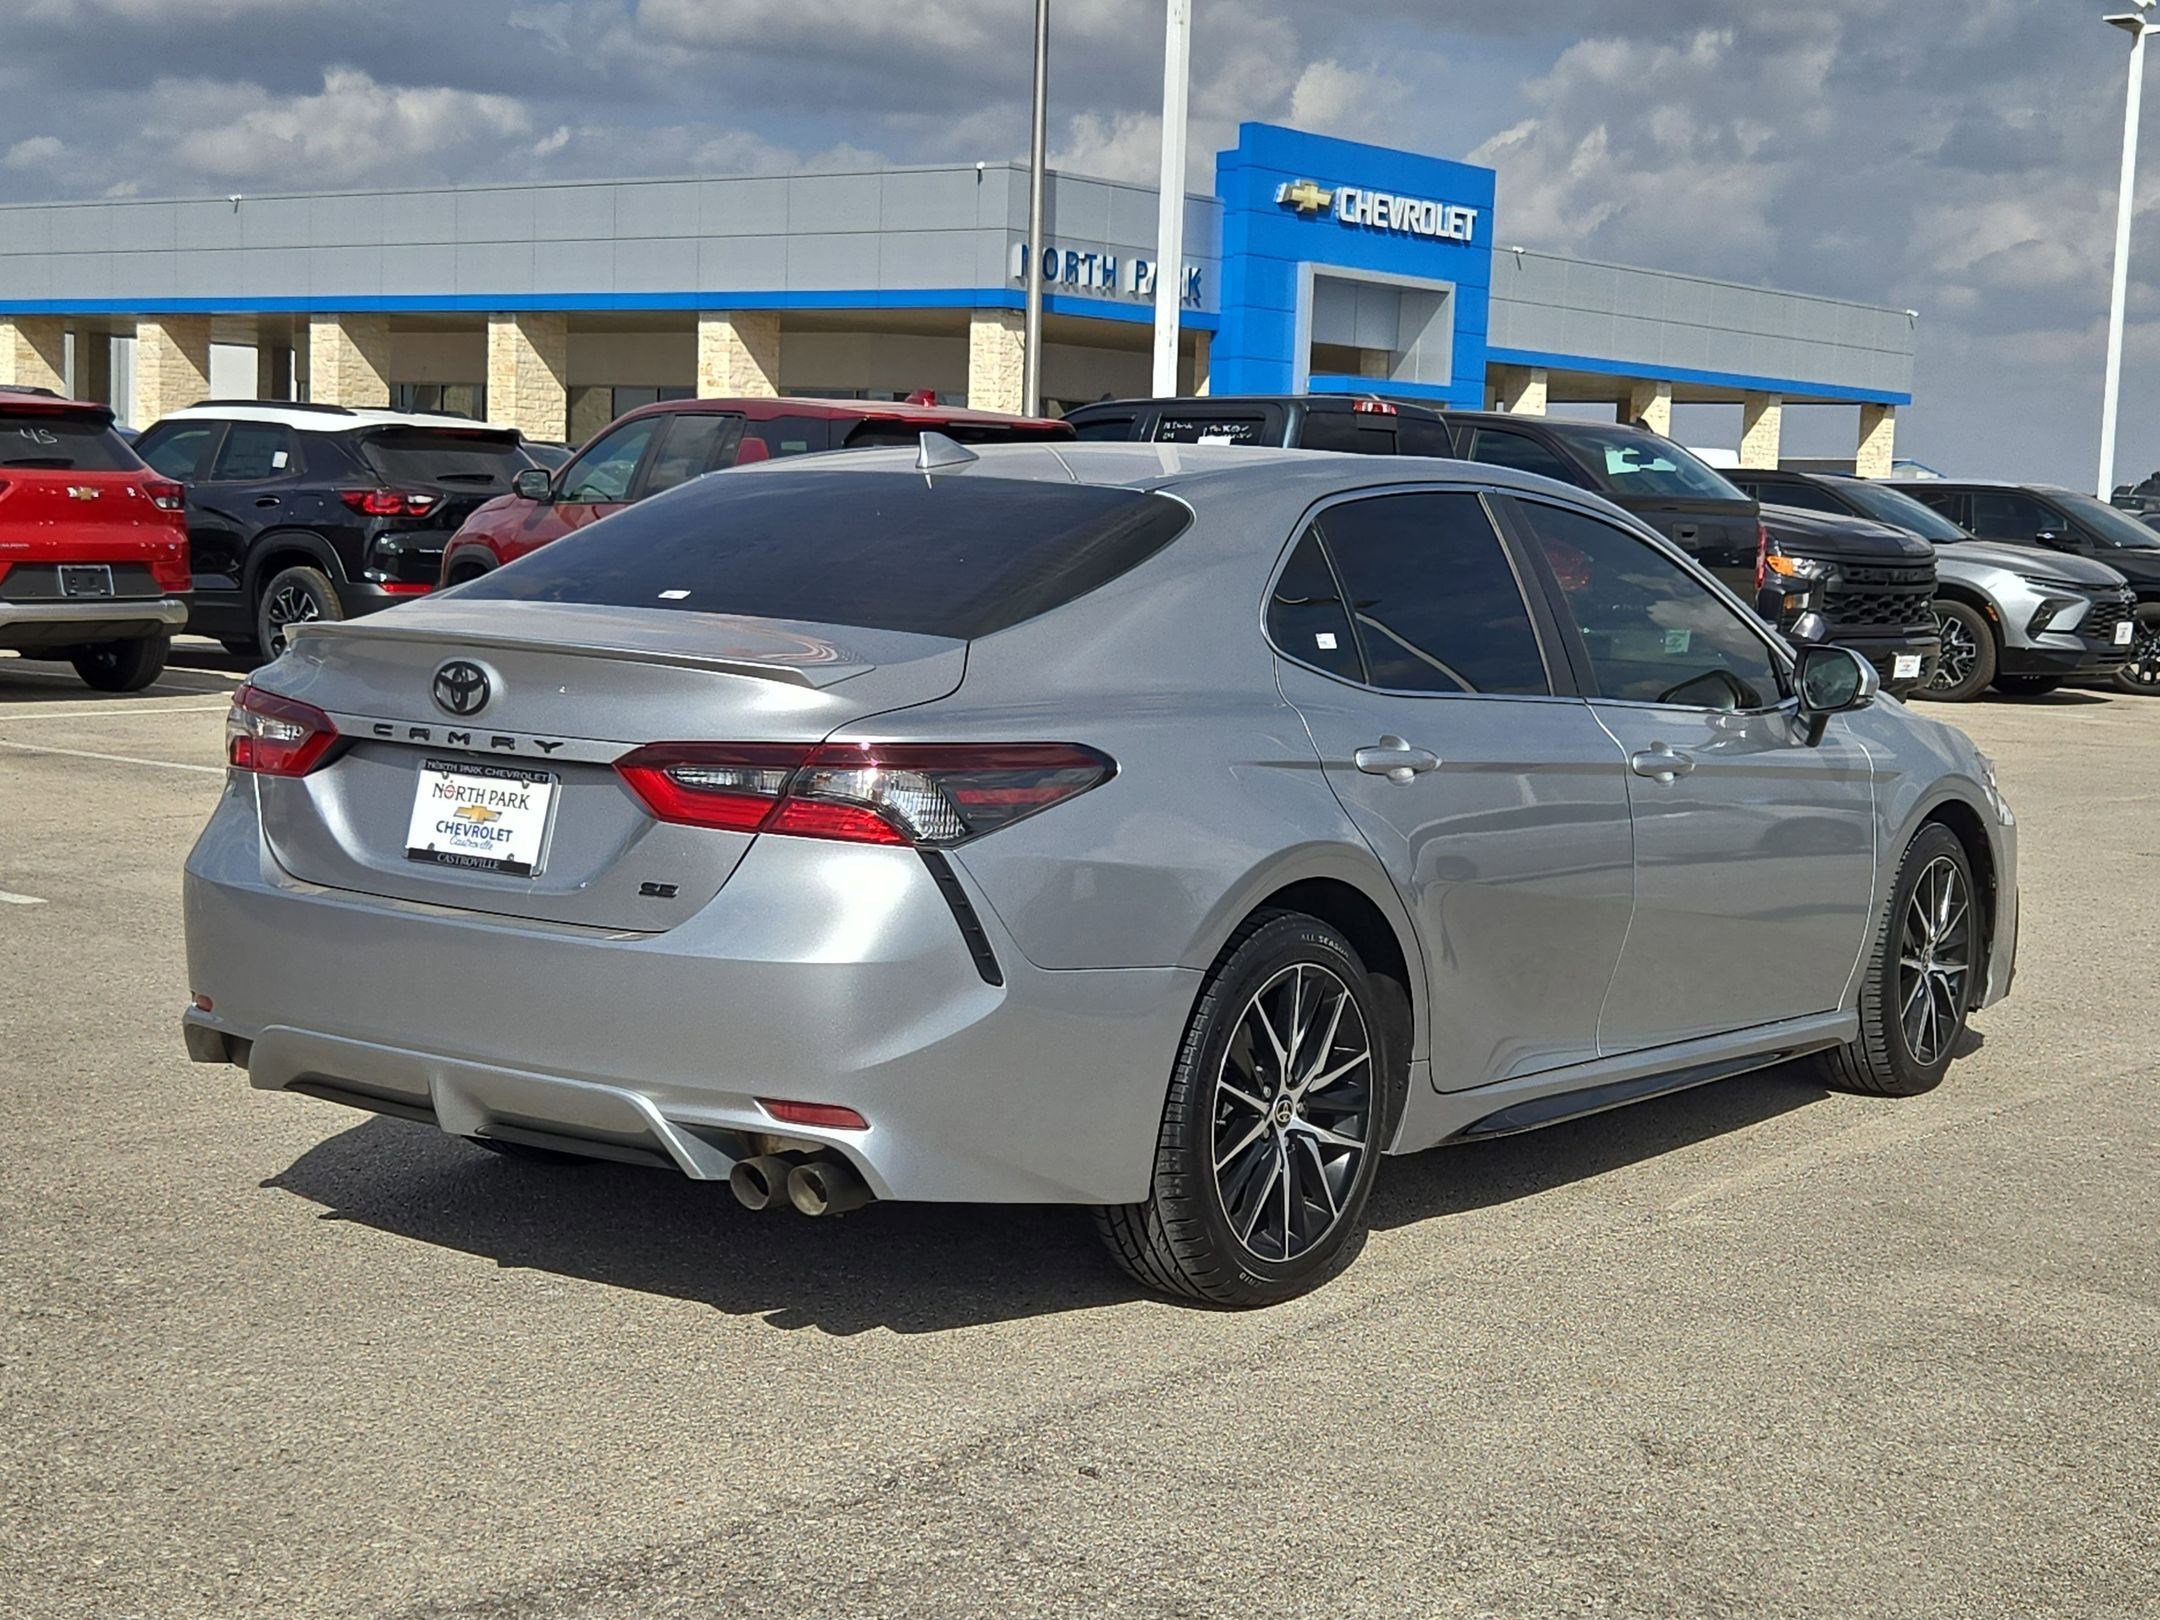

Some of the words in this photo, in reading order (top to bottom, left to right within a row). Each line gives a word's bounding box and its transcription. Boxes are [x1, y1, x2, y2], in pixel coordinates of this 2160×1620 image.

[1338, 187, 1478, 241] CHEVROLET
[1132, 259, 1202, 300] PK
[373, 723, 564, 753] CAMRY
[427, 760, 457, 772] NORTH
[460, 763, 482, 775] PARK
[485, 767, 548, 782] CHEVROLET
[432, 780, 486, 804] NORTH
[488, 790, 530, 810] PARK
[436, 820, 513, 843] CHEVROLET
[449, 835, 494, 851] Castroille
[437, 853, 499, 869] CASTROVILLE
[638, 881, 679, 898] SE
